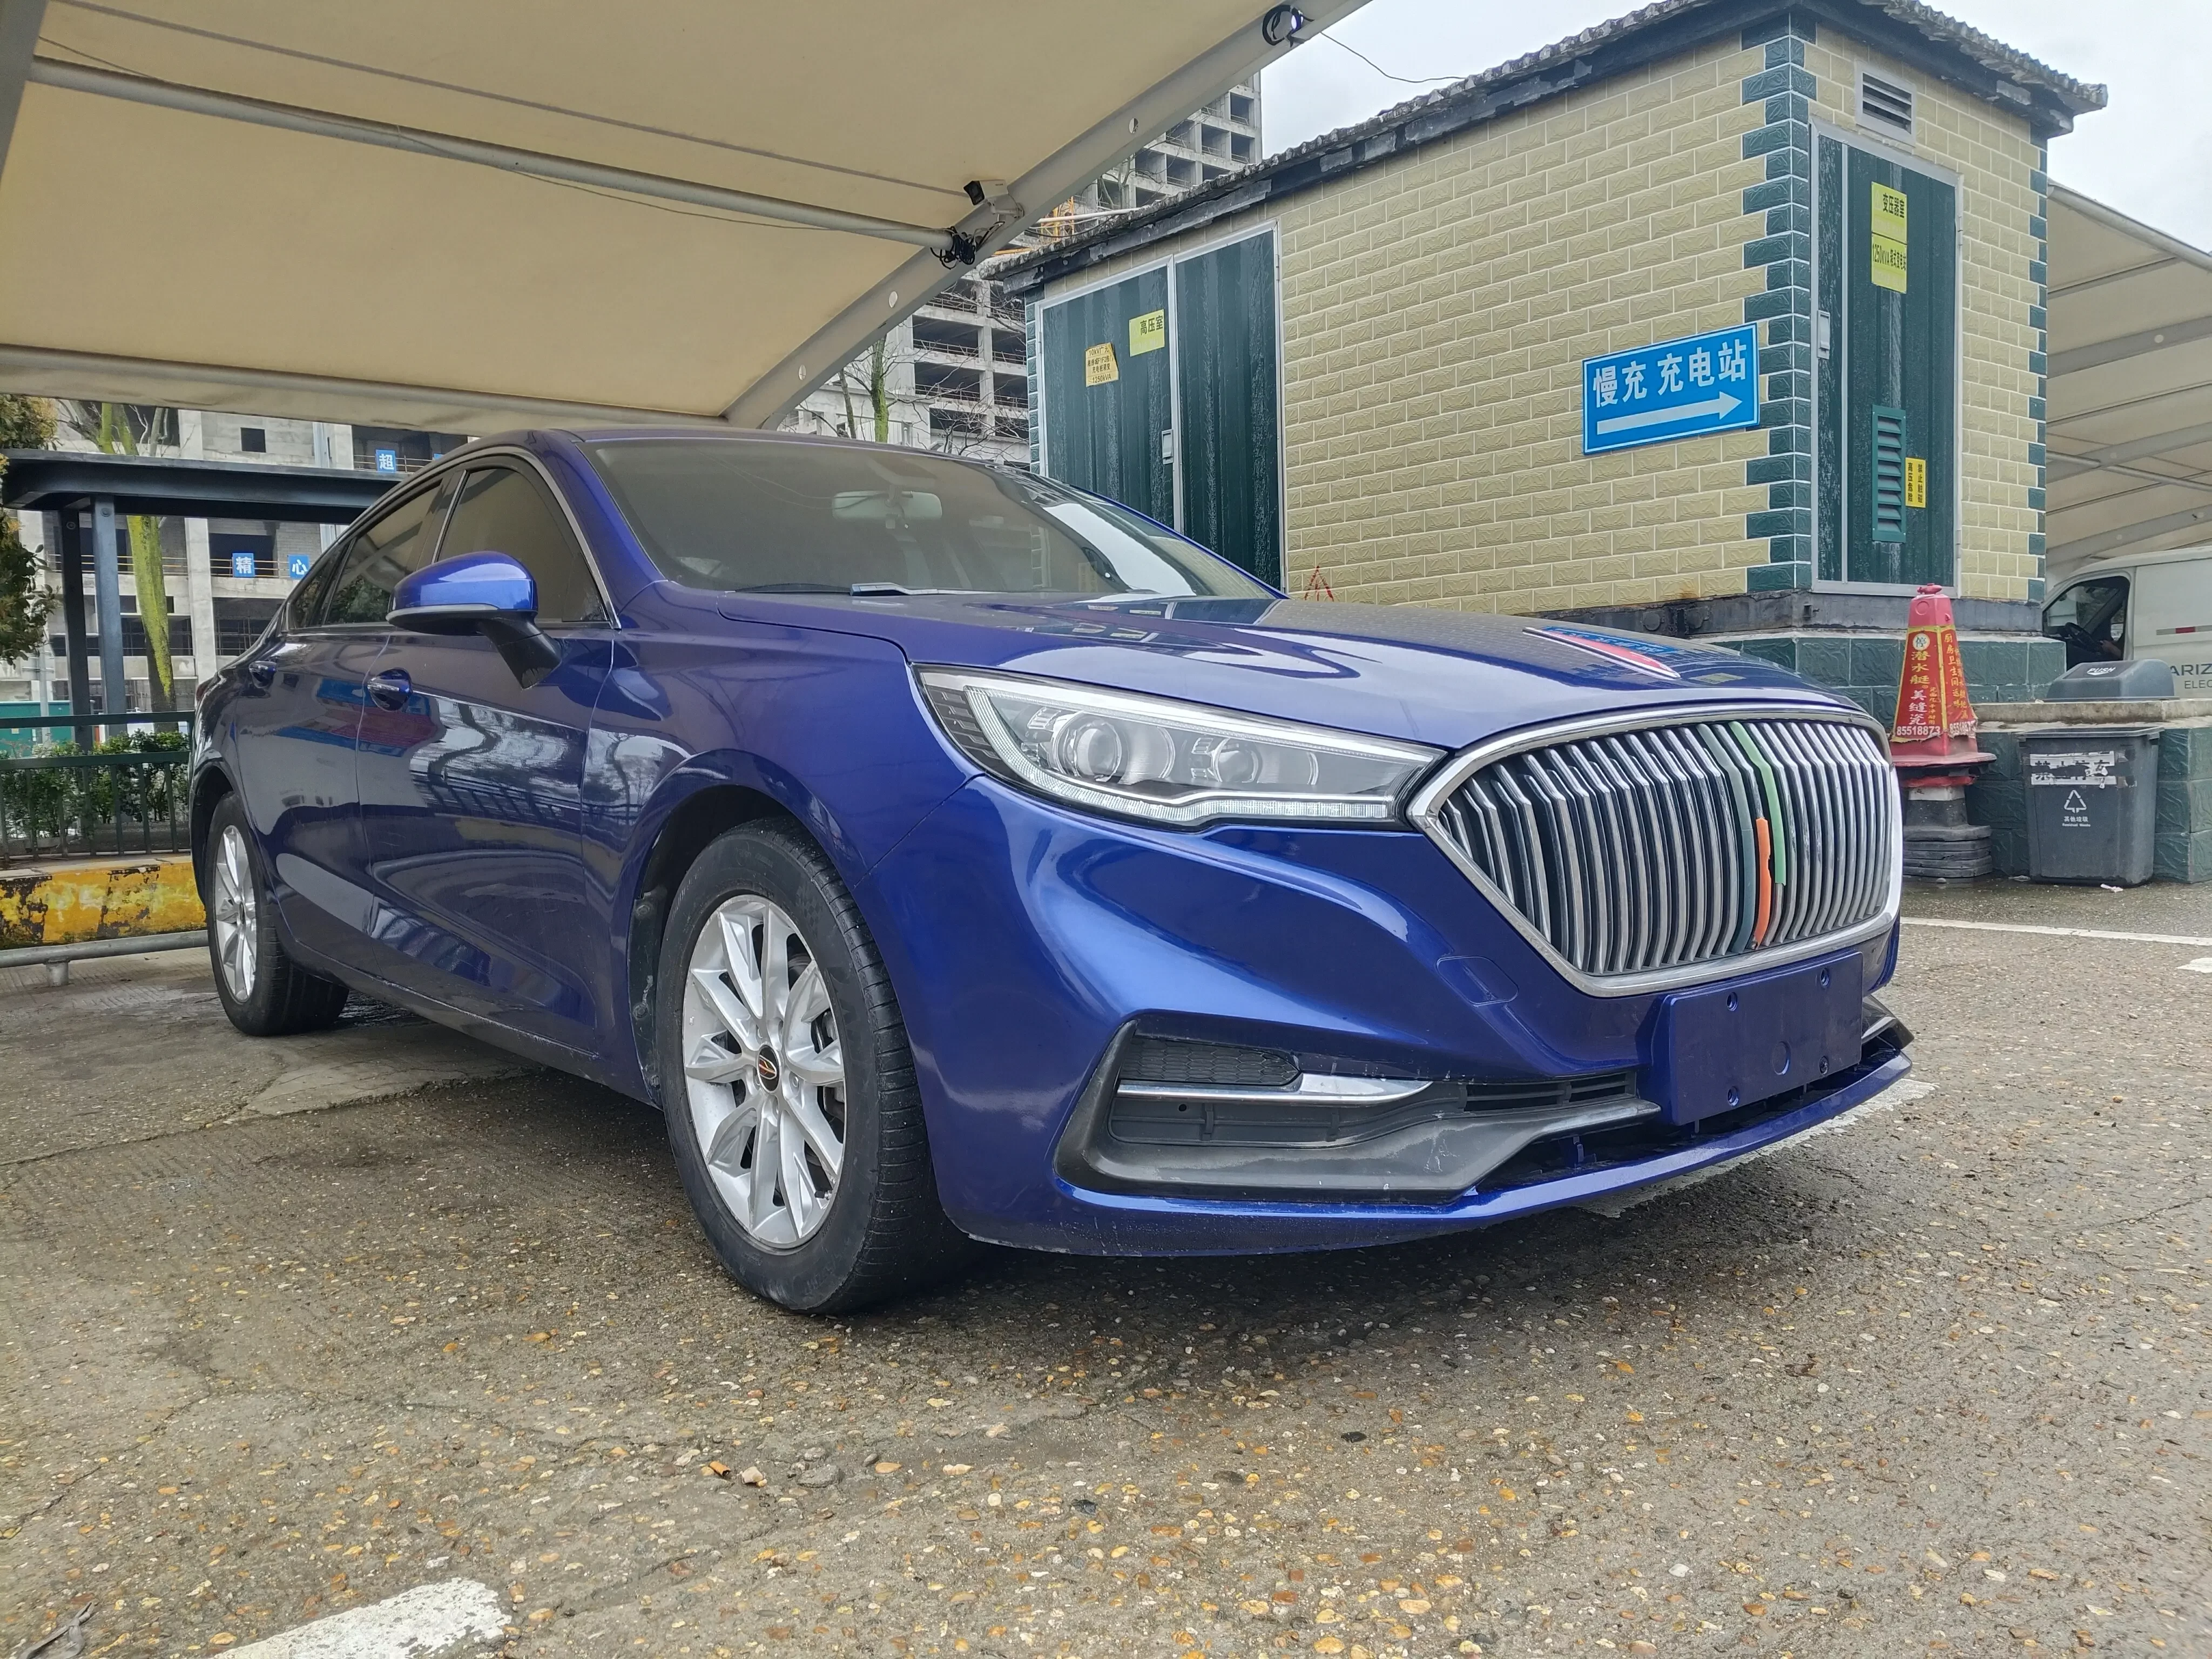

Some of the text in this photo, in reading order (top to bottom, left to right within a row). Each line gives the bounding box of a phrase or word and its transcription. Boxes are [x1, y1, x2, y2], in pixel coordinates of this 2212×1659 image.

[1883, 193, 1905, 218] 变压器室
[1140, 315, 1163, 335] 高压室
[1092, 373, 1111, 383] 1250kVA
[1593, 339, 1746, 408] 慢充 充电站
[379, 454, 394, 470] 超
[235, 557, 308, 575] 精 心
[1915, 636, 1927, 647] 停
[1910, 651, 1931, 684] 潜水艇
[1908, 690, 1927, 725] 美缝瓷
[1897, 725, 1941, 736] 85518873
